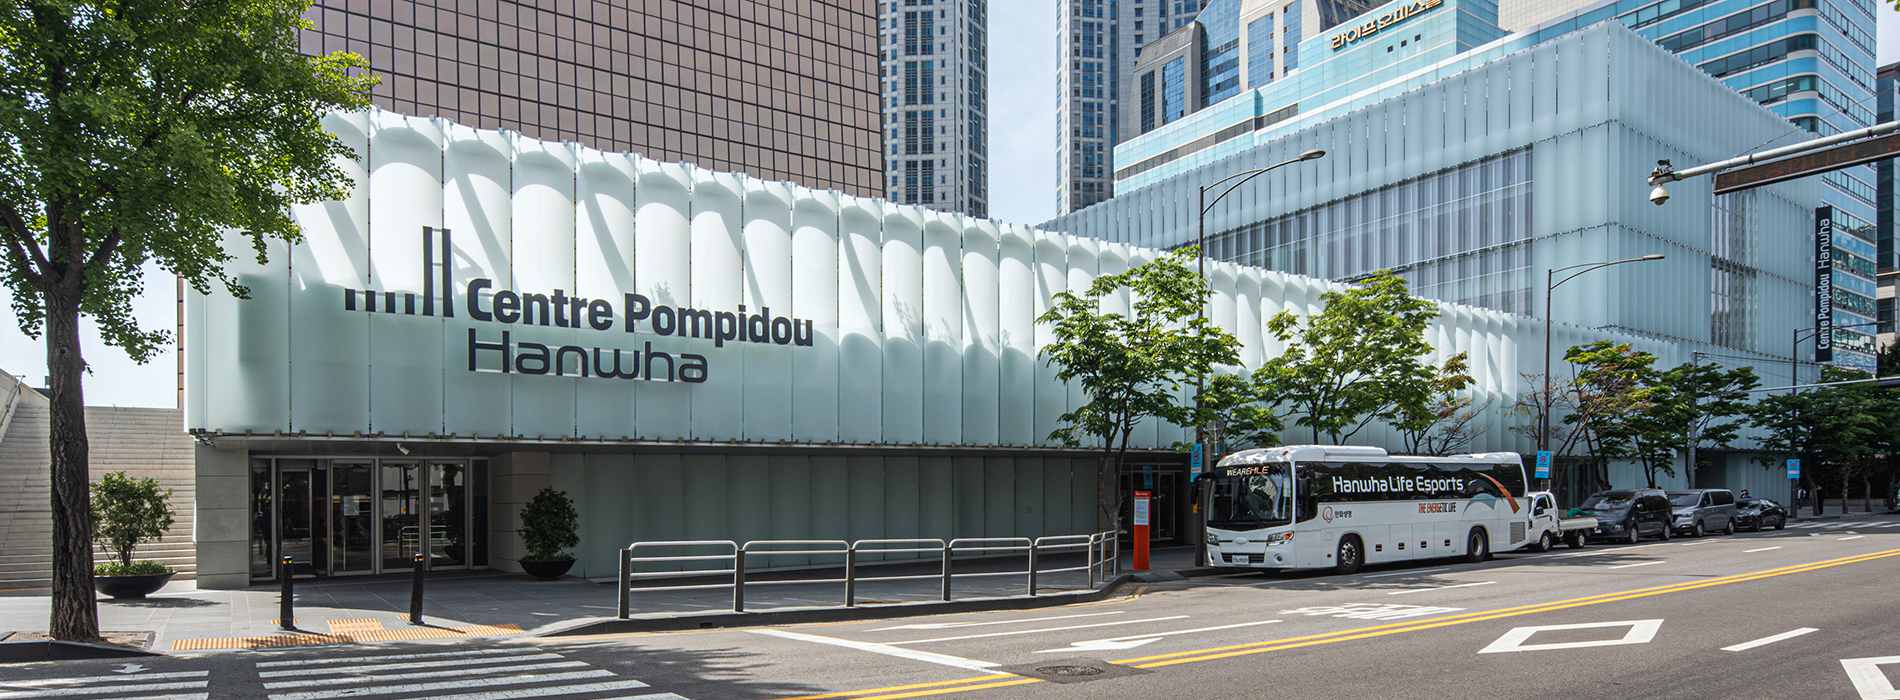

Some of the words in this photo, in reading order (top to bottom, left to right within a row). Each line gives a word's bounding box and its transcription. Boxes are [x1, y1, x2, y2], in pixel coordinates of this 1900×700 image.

[1818, 218, 1830, 269] Hanwha
[467, 278, 614, 331] Centre
[624, 292, 814, 348] Pompidou
[1818, 273, 1831, 320] Pompidou
[468, 328, 709, 384] Hanwha
[1332, 476, 1388, 493] Hanwha
[1388, 476, 1413, 492] Life
[1416, 476, 1464, 494] Esports
[1418, 503, 1426, 513] THE
[1427, 502, 1447, 513] ENERGETIC
[1448, 502, 1457, 512] LIFE
